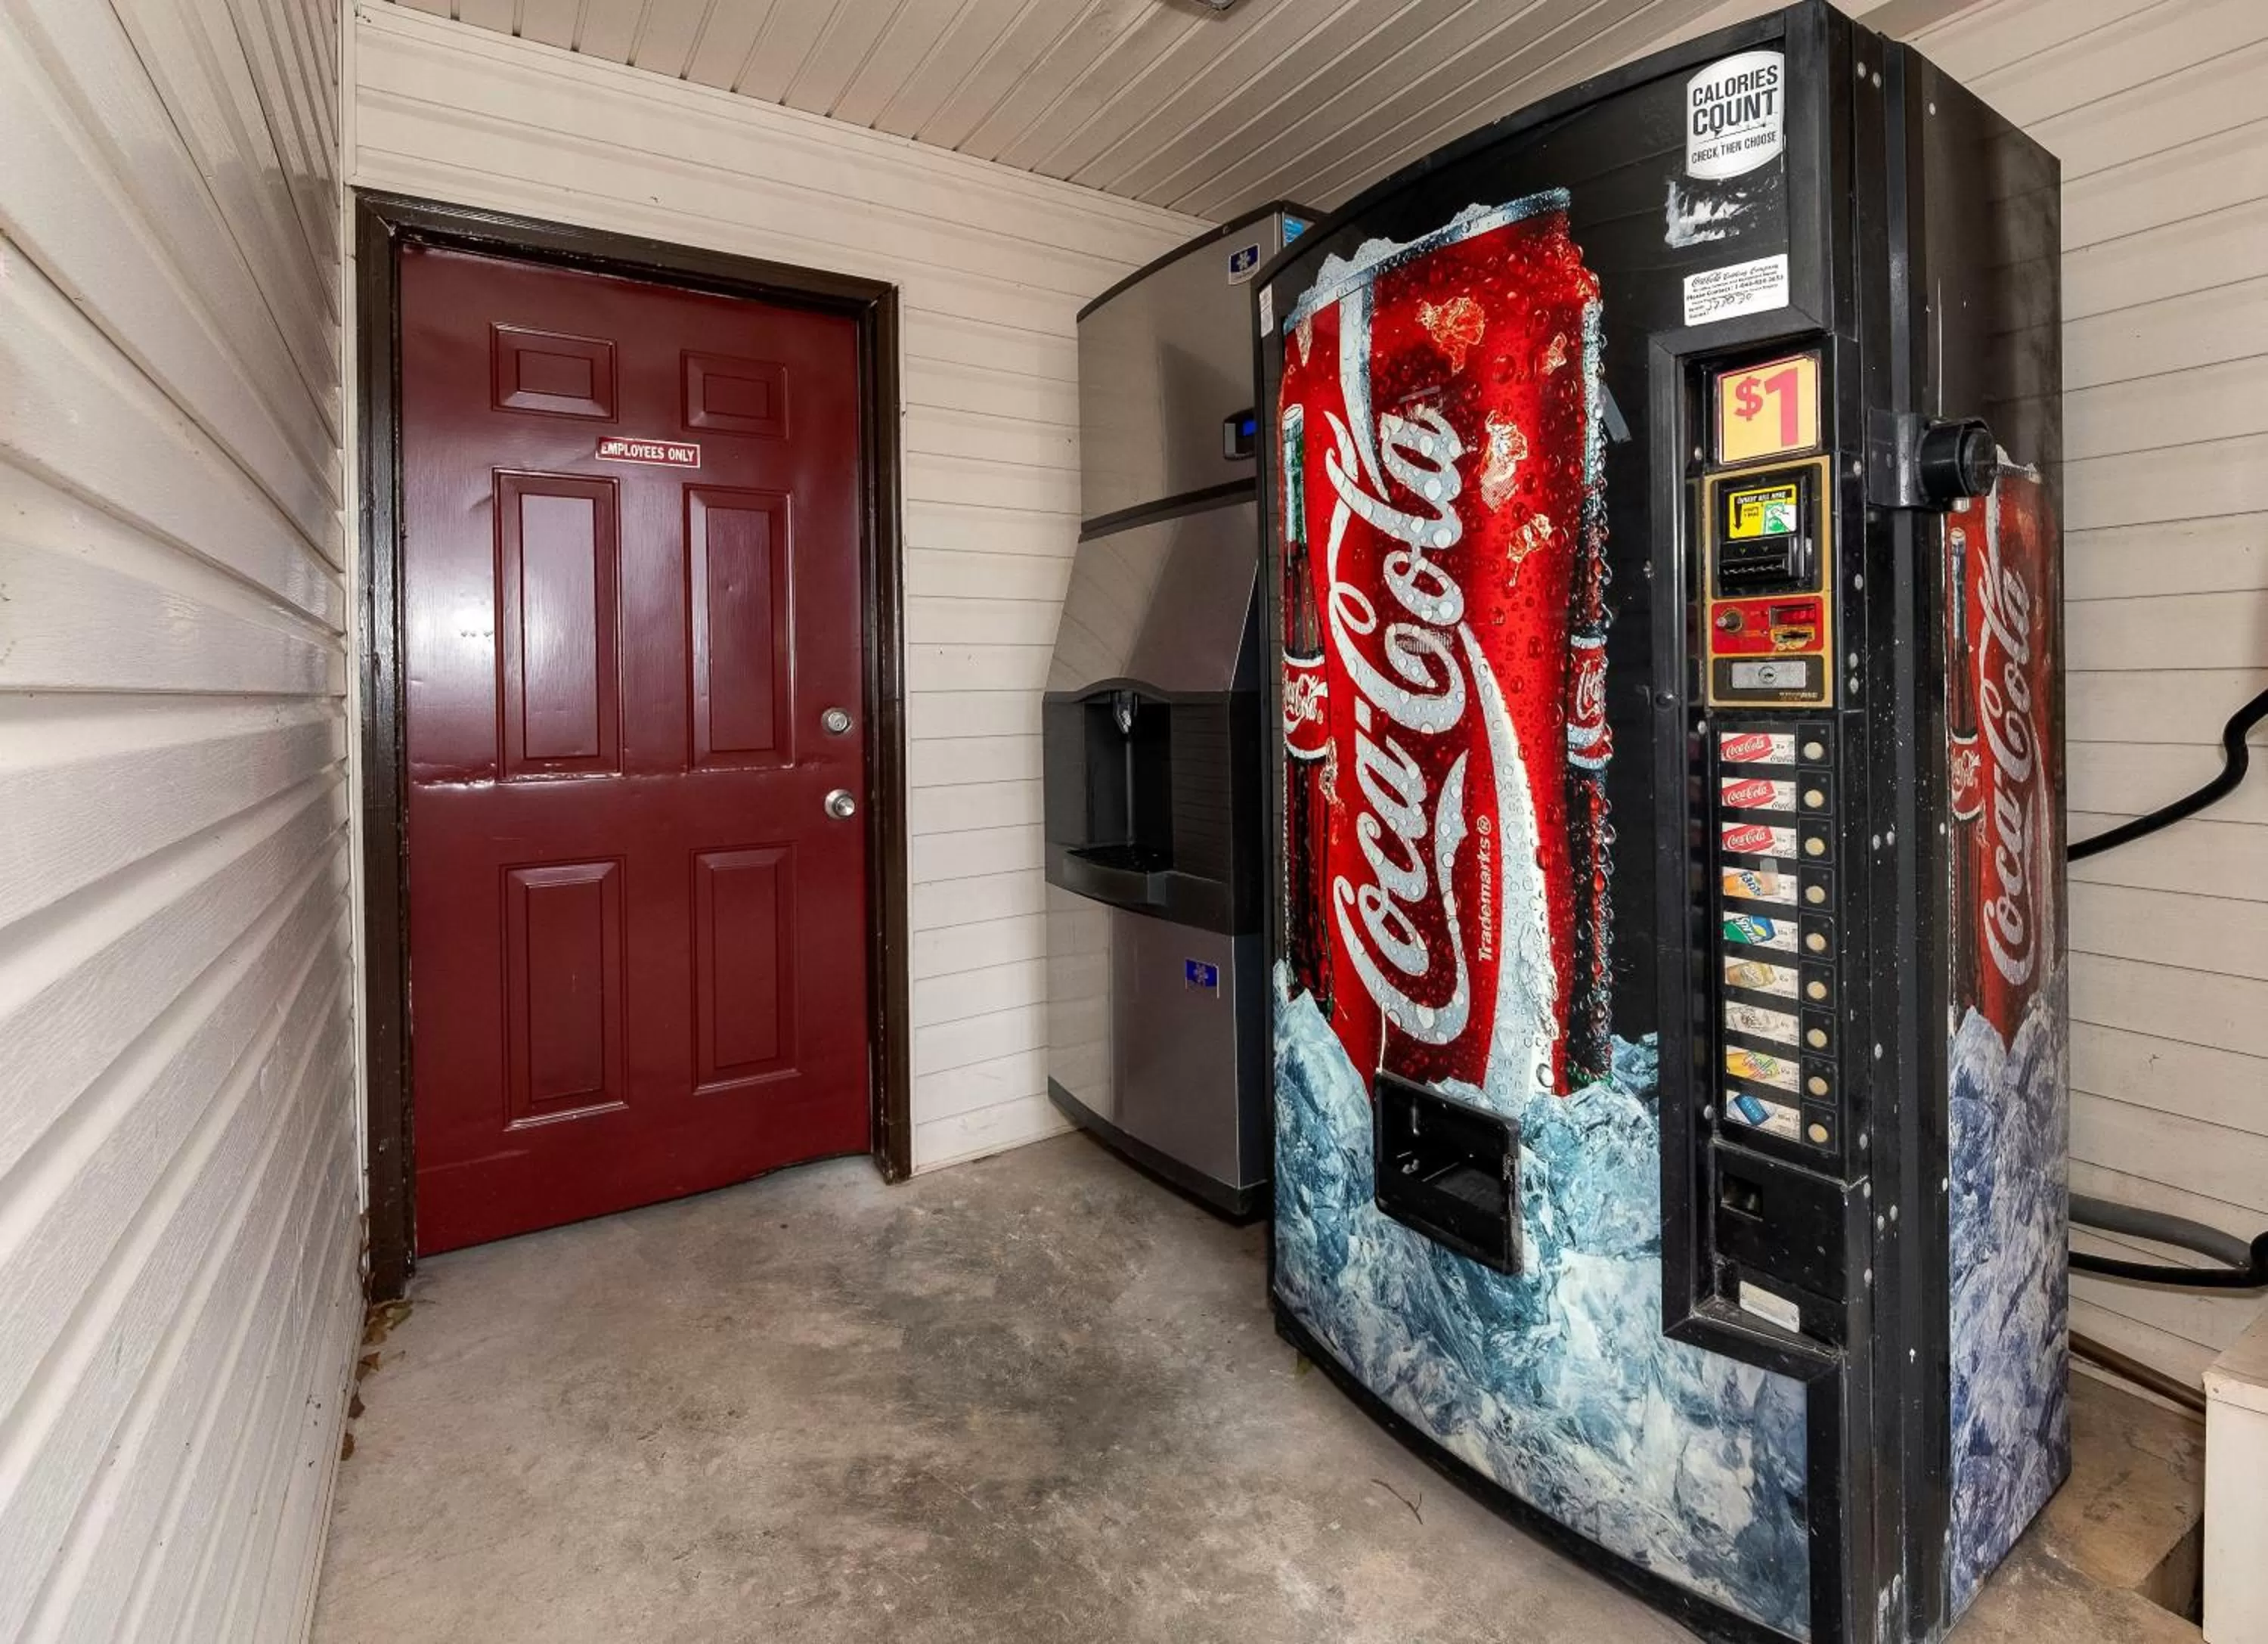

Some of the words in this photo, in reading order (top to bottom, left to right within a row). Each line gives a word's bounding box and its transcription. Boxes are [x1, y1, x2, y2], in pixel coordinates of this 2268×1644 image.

[1693, 65, 1778, 107] CALORIES
[1693, 88, 1778, 136] COUNT
[1691, 145, 1718, 164] CHECK
[1721, 140, 1742, 156] THEN
[1744, 131, 1777, 150] CHOOSE
[1734, 367, 1799, 448] $1
[600, 442, 665, 460] EMPLOYEES
[668, 448, 695, 462] ONLY
[1324, 404, 1470, 1045] Coca-Cola
[1977, 546, 2036, 985] Coca-Cola
